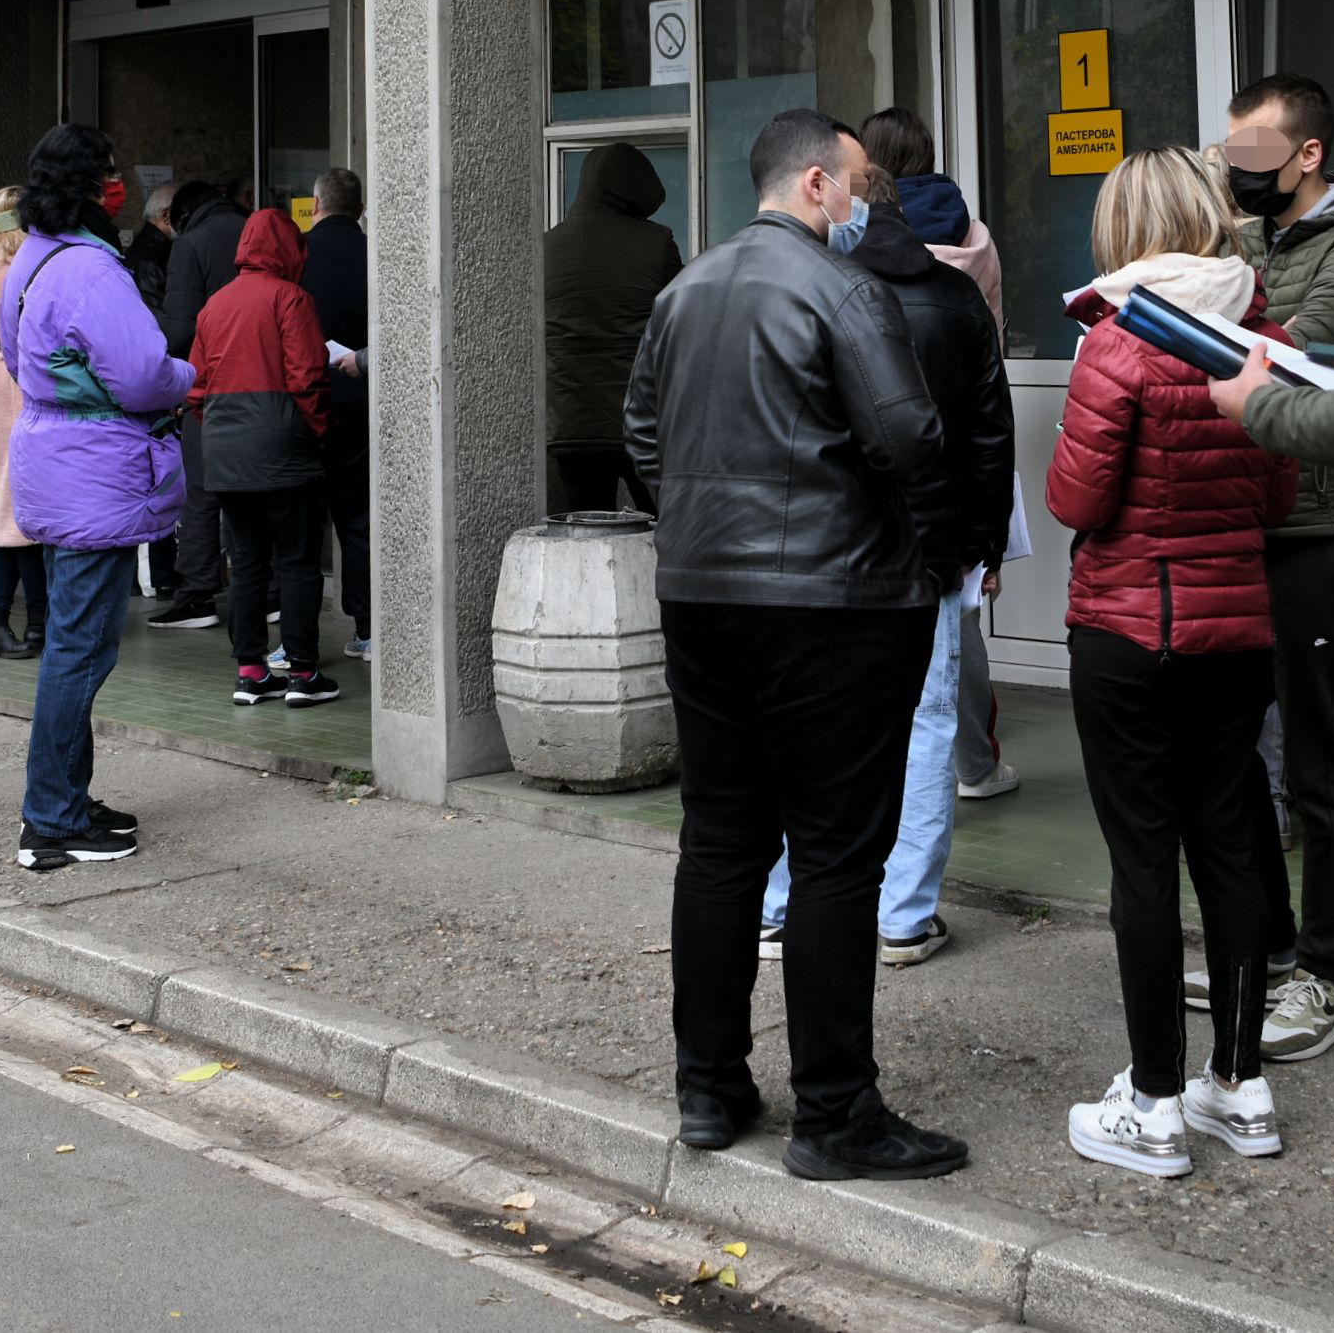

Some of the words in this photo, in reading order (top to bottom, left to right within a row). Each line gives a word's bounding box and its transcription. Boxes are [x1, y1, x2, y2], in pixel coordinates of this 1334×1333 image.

[1077, 53, 1089, 87] 1
[1055, 128, 1116, 142] ПАСТЕРОВА
[1055, 142, 1117, 155] АМБУЛАНТА
